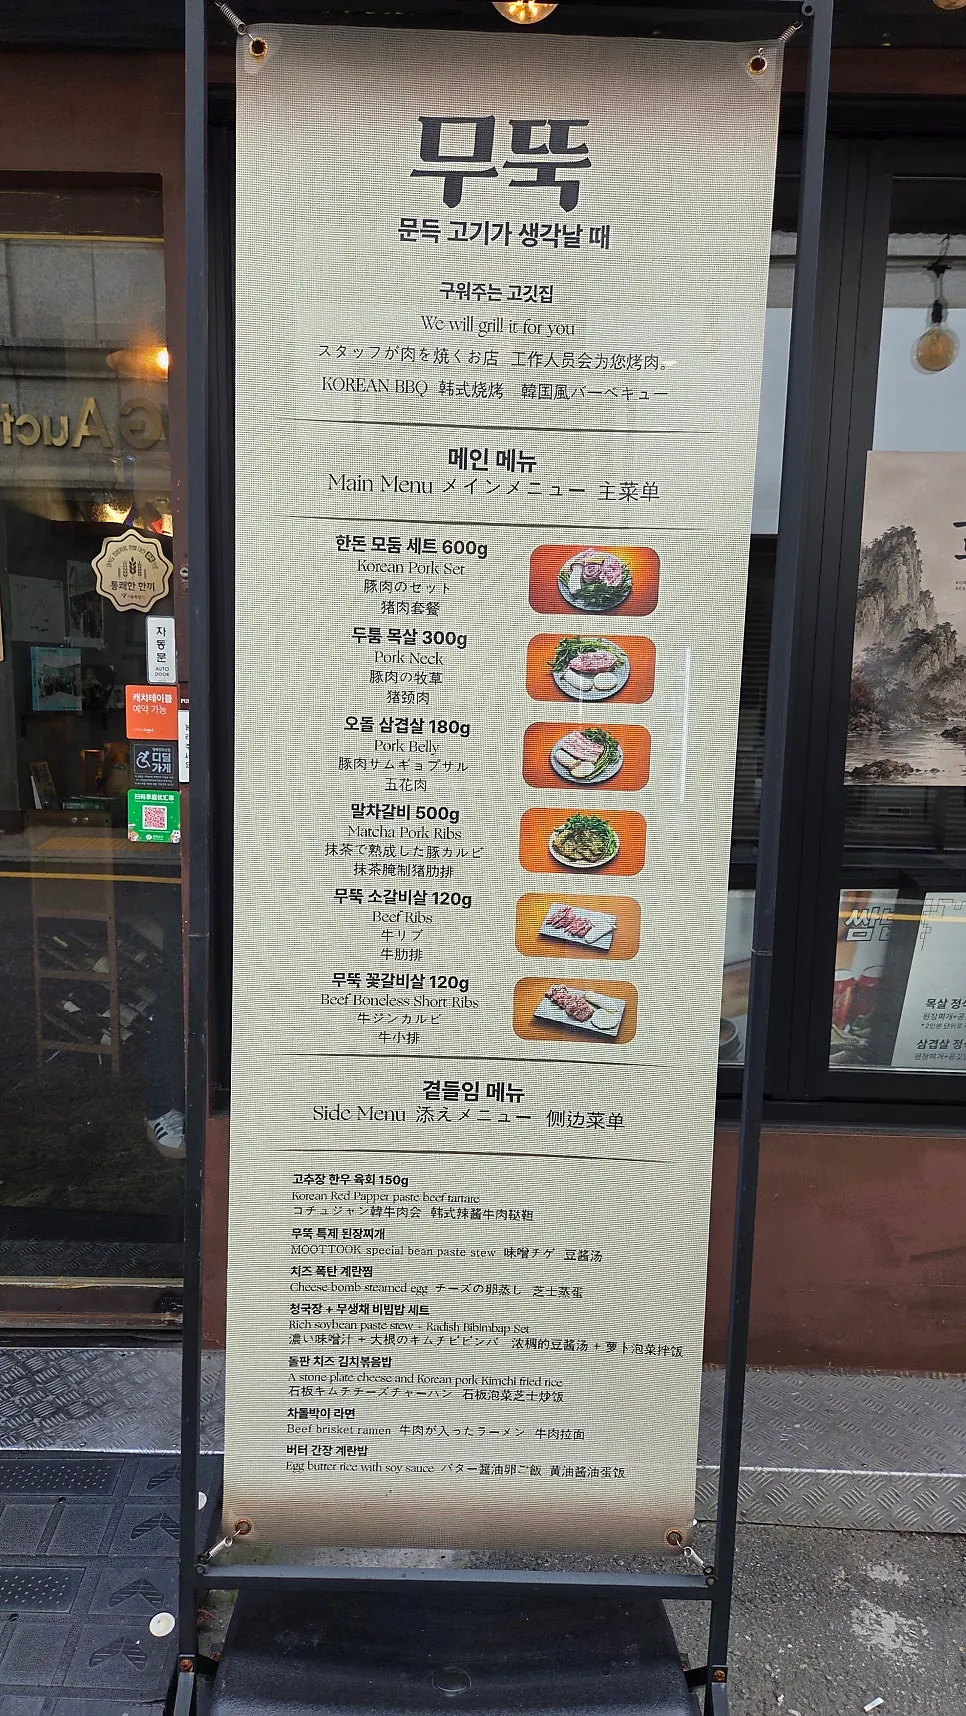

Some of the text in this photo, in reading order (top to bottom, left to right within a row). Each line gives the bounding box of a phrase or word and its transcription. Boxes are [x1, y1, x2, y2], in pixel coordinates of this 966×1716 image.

[410, 115, 592, 213] 무뚝
[398, 217, 611, 250] 문득 고기가 생각날 때
[439, 282, 553, 303] 구워주는 고깃집
[421, 315, 575, 337] We will grill it for you
[318, 343, 669, 371] スタッフが肉を焼くお店 工作人员会为您烤肉。
[322, 376, 668, 401] KOREAN BBQ 韩式烧烤 韓国風バーベキュー
[448, 448, 537, 473] 메인 메뉴
[328, 474, 660, 502] Main Menu メインメニュー 主菜单
[336, 535, 488, 559] 한돈 모둠 세트 600g
[357, 560, 465, 575] Korean Pork Set
[137, 581, 155, 591] 한끼
[364, 579, 450, 594] 豚肉のセット
[381, 600, 440, 616] 猪肉套餐
[156, 626, 166, 663] 자동문
[352, 627, 467, 649] 두툼 목살 300g
[375, 650, 443, 665] Pork Neck
[370, 670, 443, 685] 豚肉の牧草
[132, 693, 172, 703] 캐치테이블
[387, 690, 430, 705] 猪颈肉
[133, 705, 167, 714] 예약 가능
[344, 717, 470, 737] 오돌 삼겹살 180g
[375, 739, 440, 755] Pork Belly
[152, 763, 171, 773] 가게
[339, 757, 468, 772] 豚肉サムギョプサル
[385, 778, 427, 791] 五花肉
[352, 803, 460, 823] 말차갈비 500g
[349, 825, 462, 840] Matcha Pork Ribs
[333, 888, 472, 908] 무뚝 소갈비살 120g
[373, 911, 433, 923] Beef Ribs
[380, 948, 423, 961] 牛肋排
[332, 972, 469, 992] 무뚝 꽃갈비살 120g
[321, 993, 479, 1009] Beef Boneless Short Ribs
[926, 999, 948, 1009] 목살
[378, 1031, 420, 1044] 牛小排
[917, 1039, 950, 1049] 삼겹살
[422, 1080, 525, 1103] 곁들임 메뉴
[312, 1103, 626, 1131] Side Menu 添えメニュー 侧边菜单
[292, 1174, 409, 1187] 고추장 한우 육회 150g
[292, 1191, 328, 1200] Korean
[331, 1192, 350, 1200] Red
[392, 1193, 420, 1203] paste
[422, 1192, 447, 1202] beef
[448, 1194, 480, 1203] tartare
[291, 1228, 385, 1240] 무뚝 특제 된장찌개
[290, 1244, 496, 1258] MOOTTOOK special bean paste stew
[291, 1265, 373, 1278] 치즈 폭탄 계란찜
[290, 1282, 522, 1296] Cheese bomb steamed egg チーズの卵蒸し
[290, 1303, 430, 1316] 청국장 무생채 비빔밥 세트
[289, 1320, 312, 1329] Rich
[314, 1321, 357, 1330] soybean
[360, 1322, 387, 1332] paste
[426, 1322, 459, 1331] Radish
[514, 1325, 530, 1333] Set
[313, 1356, 392, 1368] 치즈 김치볶음밥
[299, 1374, 327, 1382] stone
[330, 1374, 354, 1385] plate
[356, 1374, 392, 1383] cheese
[395, 1374, 414, 1383] and
[417, 1375, 452, 1384] Korean
[455, 1375, 479, 1387] pork
[481, 1376, 516, 1386] Kimchi
[519, 1377, 542, 1386] fried
[544, 1378, 563, 1387] rice
[288, 1408, 355, 1419] 차돌박이 라면
[287, 1424, 585, 1441] Beef brisket ramen 牛肉が入ったラーメン 牛肉拉面
[287, 1445, 368, 1457] 버터 간장 계란밥
[286, 1461, 435, 1474] Egg butter rice with soy sauce
